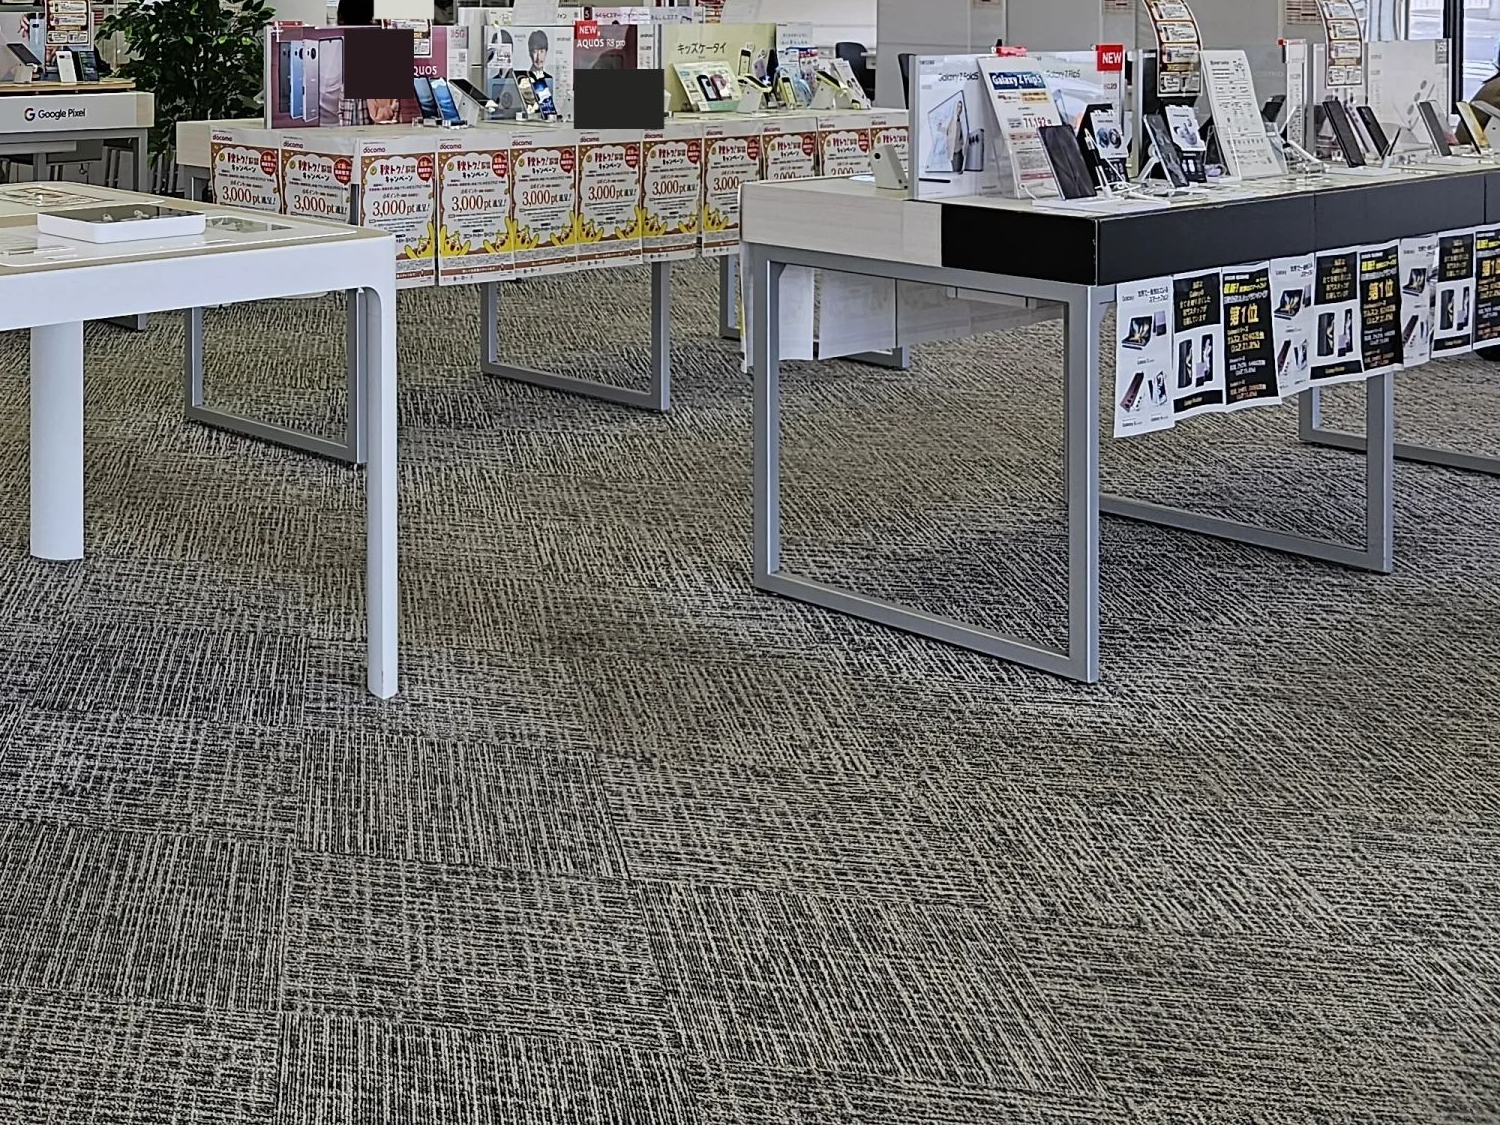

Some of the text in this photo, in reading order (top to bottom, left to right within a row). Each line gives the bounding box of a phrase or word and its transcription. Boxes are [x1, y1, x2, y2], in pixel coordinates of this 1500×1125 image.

[579, 26, 597, 34] NEW
[576, 39, 604, 48] AQUOS
[677, 42, 727, 55] キッズケータイ
[1102, 52, 1122, 64] NEW
[992, 74, 1018, 86] Galaxy
[38, 108, 67, 121] Google
[68, 108, 86, 119] Pixel
[212, 134, 233, 142] docomo
[579, 135, 600, 143] docomo
[283, 141, 304, 149] docomo
[440, 142, 462, 150] docomo
[363, 146, 386, 154] docomo
[1229, 303, 1259, 327] 第1位
